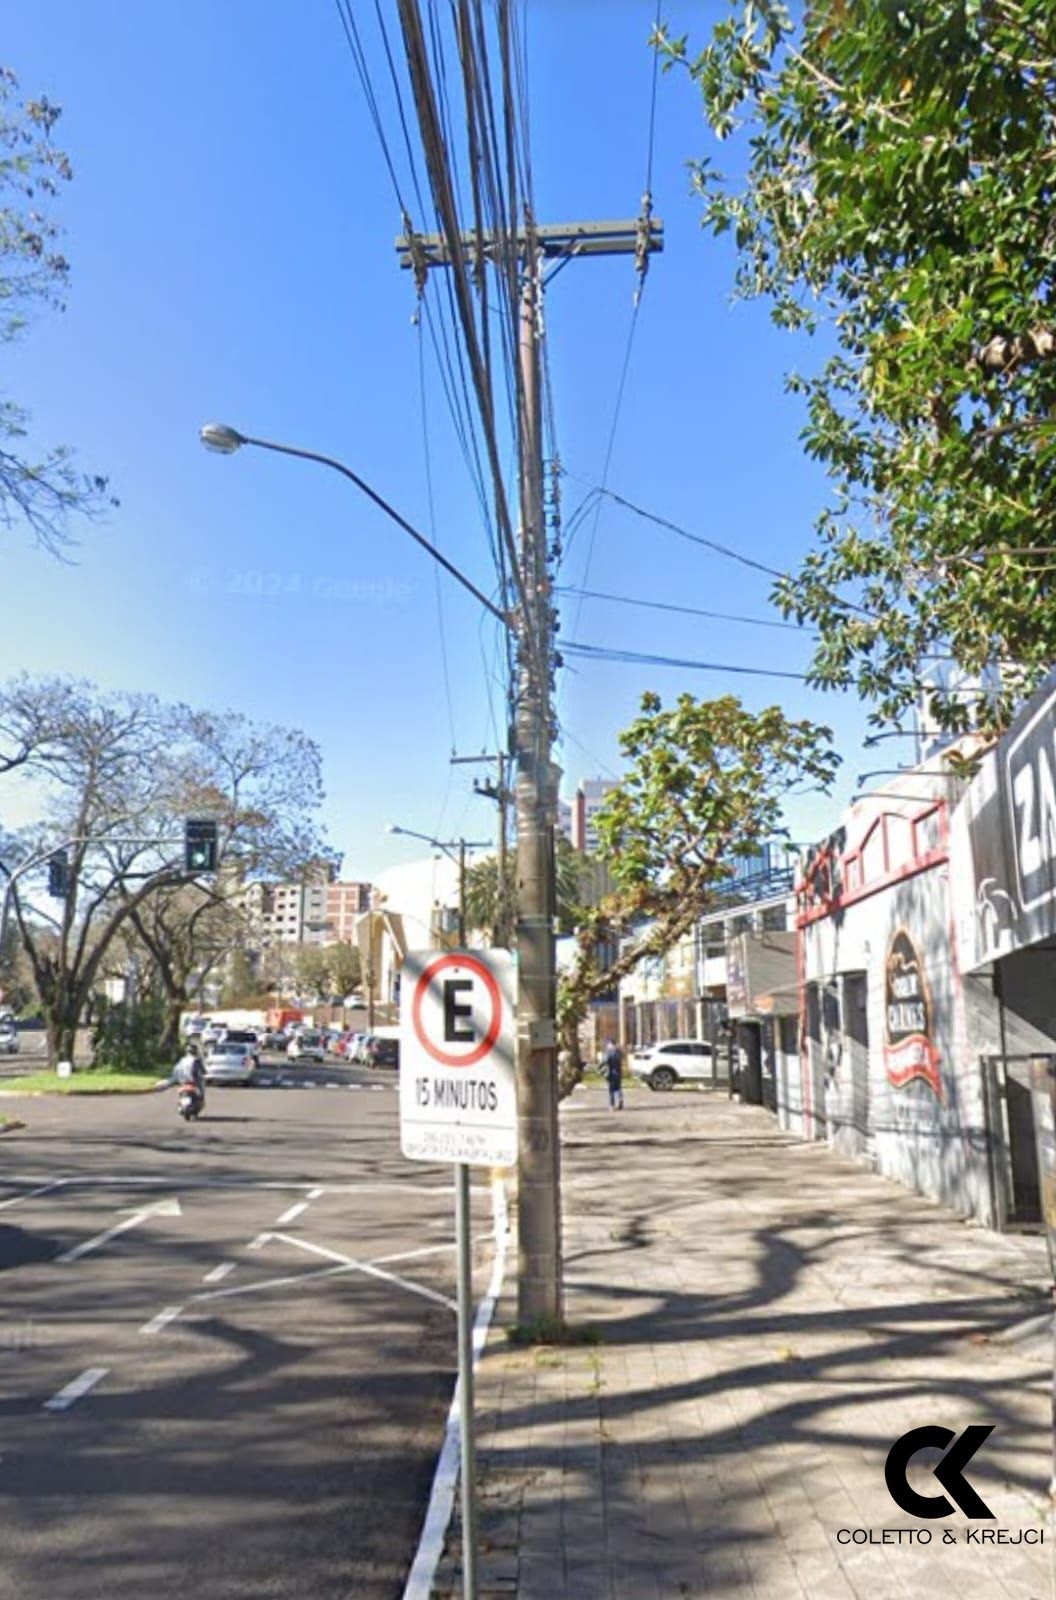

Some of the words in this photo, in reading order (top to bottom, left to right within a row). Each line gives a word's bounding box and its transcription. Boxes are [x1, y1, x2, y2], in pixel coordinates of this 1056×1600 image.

[443, 980, 475, 1043] E
[416, 1077, 430, 1106] 15
[434, 1078, 498, 1111] MINUTOS
